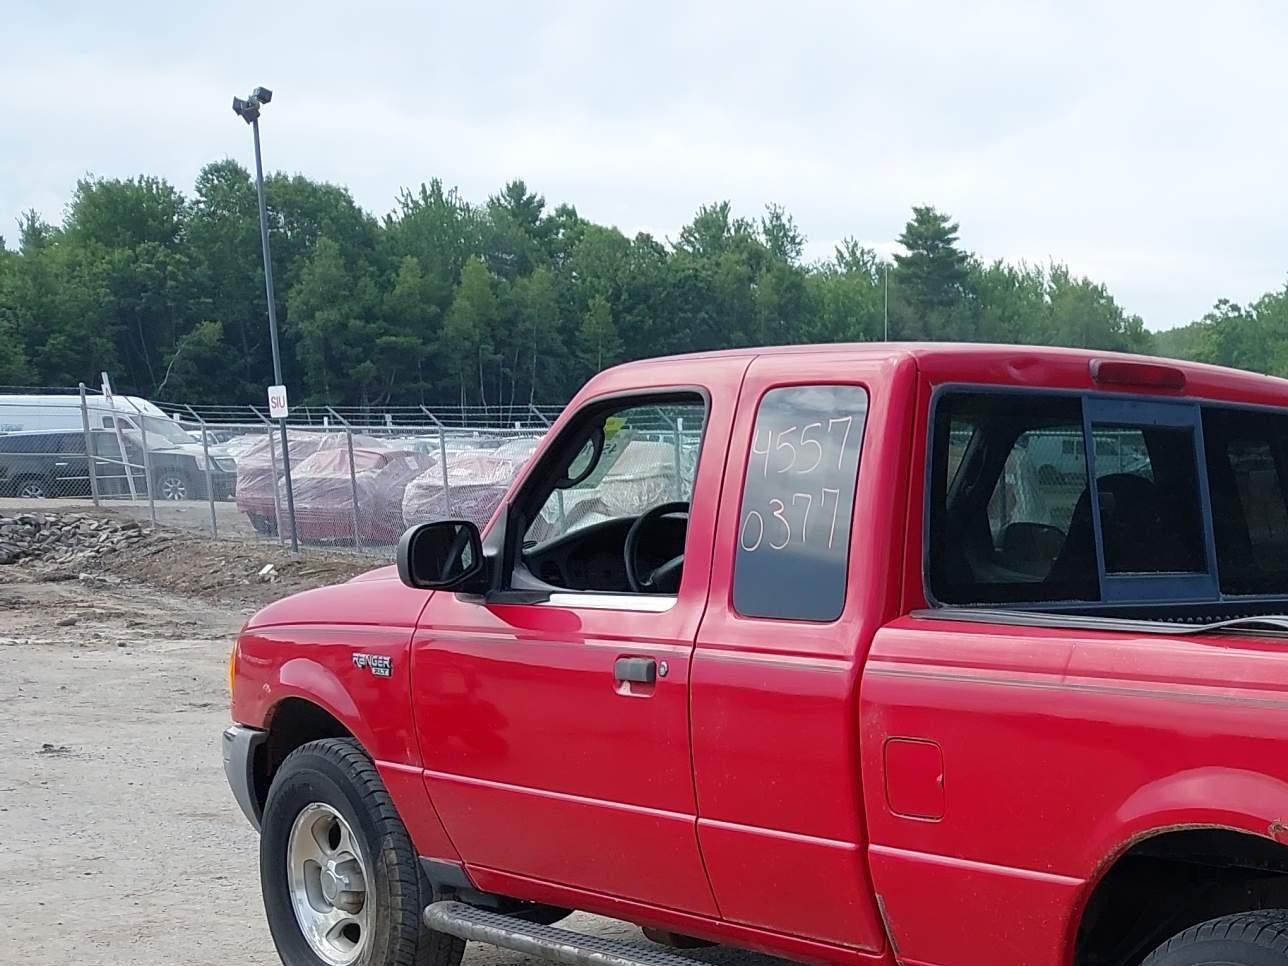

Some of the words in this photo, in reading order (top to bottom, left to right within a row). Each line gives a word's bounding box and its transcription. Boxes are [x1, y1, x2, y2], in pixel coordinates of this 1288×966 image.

[270, 396, 286, 409] SIU
[753, 416, 852, 478] 4557
[740, 488, 840, 552] 0377
